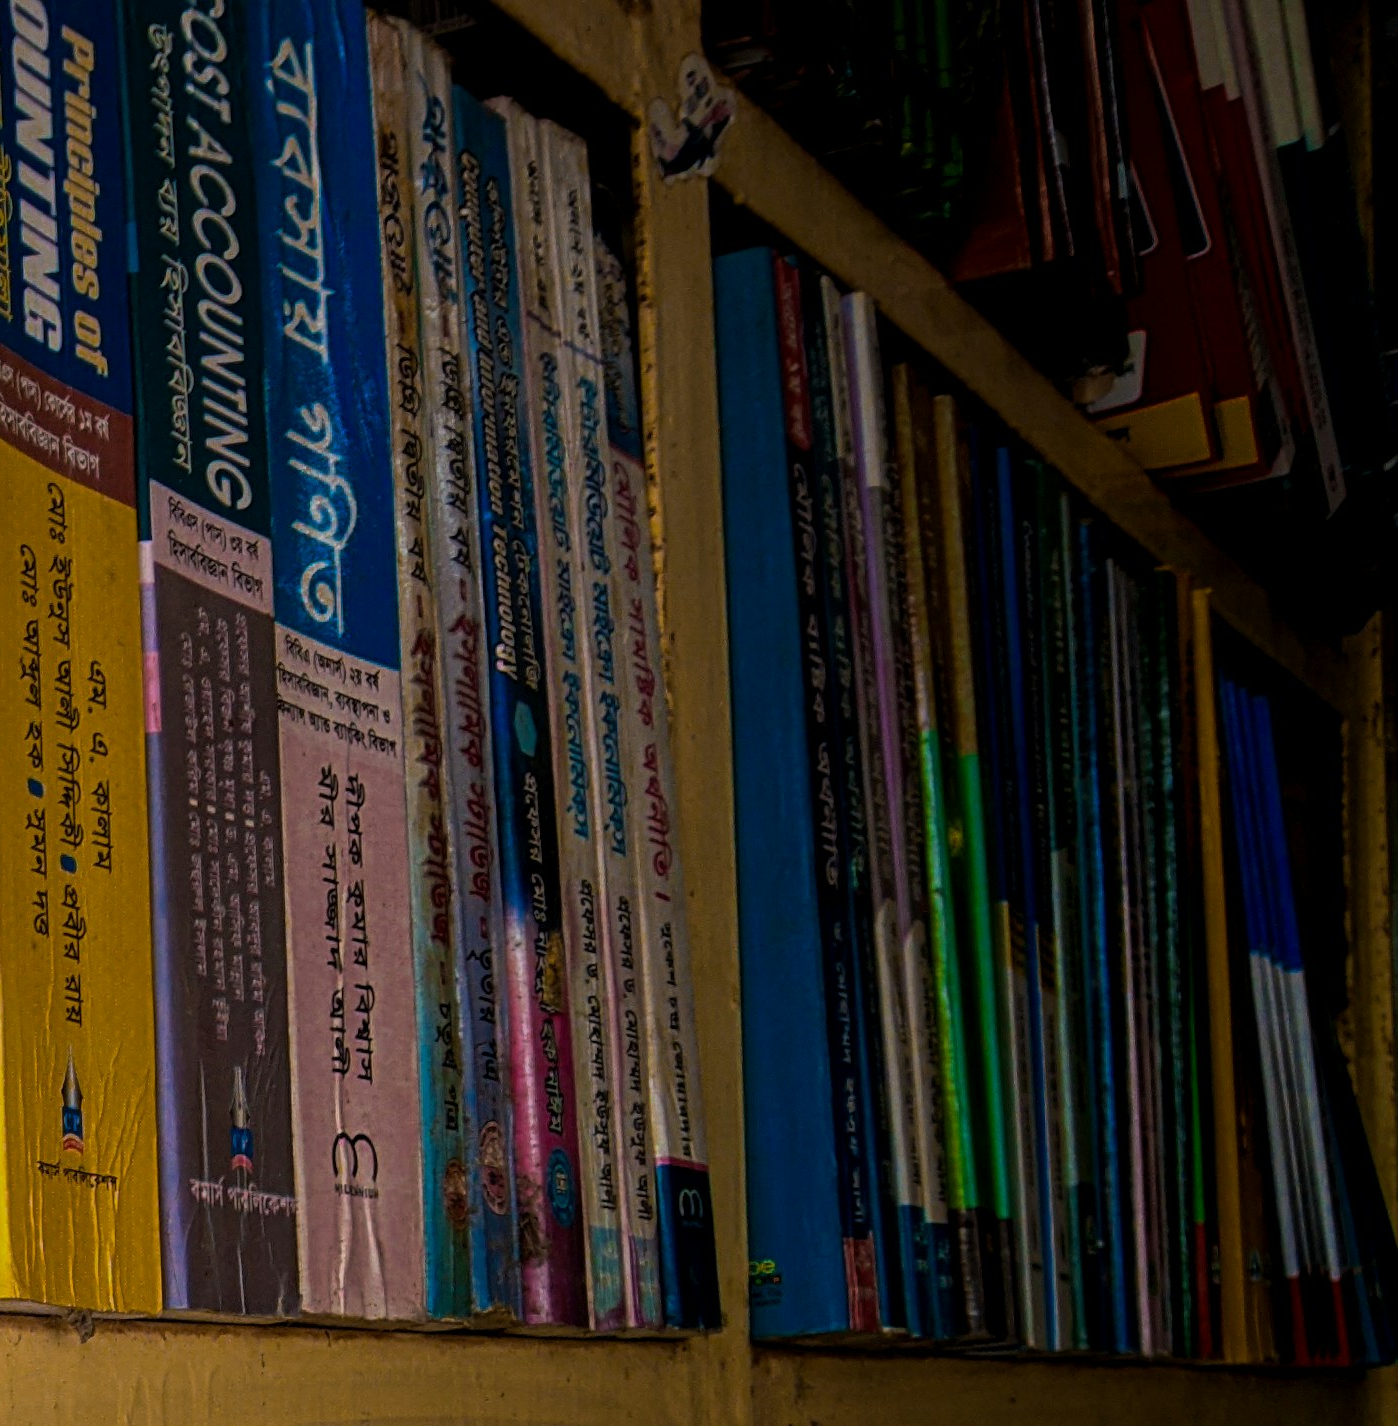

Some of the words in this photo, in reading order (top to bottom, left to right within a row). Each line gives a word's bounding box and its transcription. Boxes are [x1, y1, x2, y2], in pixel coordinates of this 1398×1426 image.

[61, 25, 104, 301] Principles
[265, 36, 336, 366] ব্যবসায়
[74, 310, 108, 378] of
[185, 113, 253, 511] ACCOUNTING
[47, 482, 68, 542] মোঃ
[282, 402, 358, 638] গণিত
[18, 543, 41, 605] মোঃ
[492, 524, 519, 681] Technology
[53, 659, 76, 732] আলী
[23, 720, 45, 773] হক
[91, 780, 115, 875] কালাম
[342, 773, 367, 869] দীপক
[315, 765, 337, 831] মীর
[327, 988, 353, 1077] আলী
[345, 879, 371, 970] কুমার
[59, 975, 86, 1028] রায়
